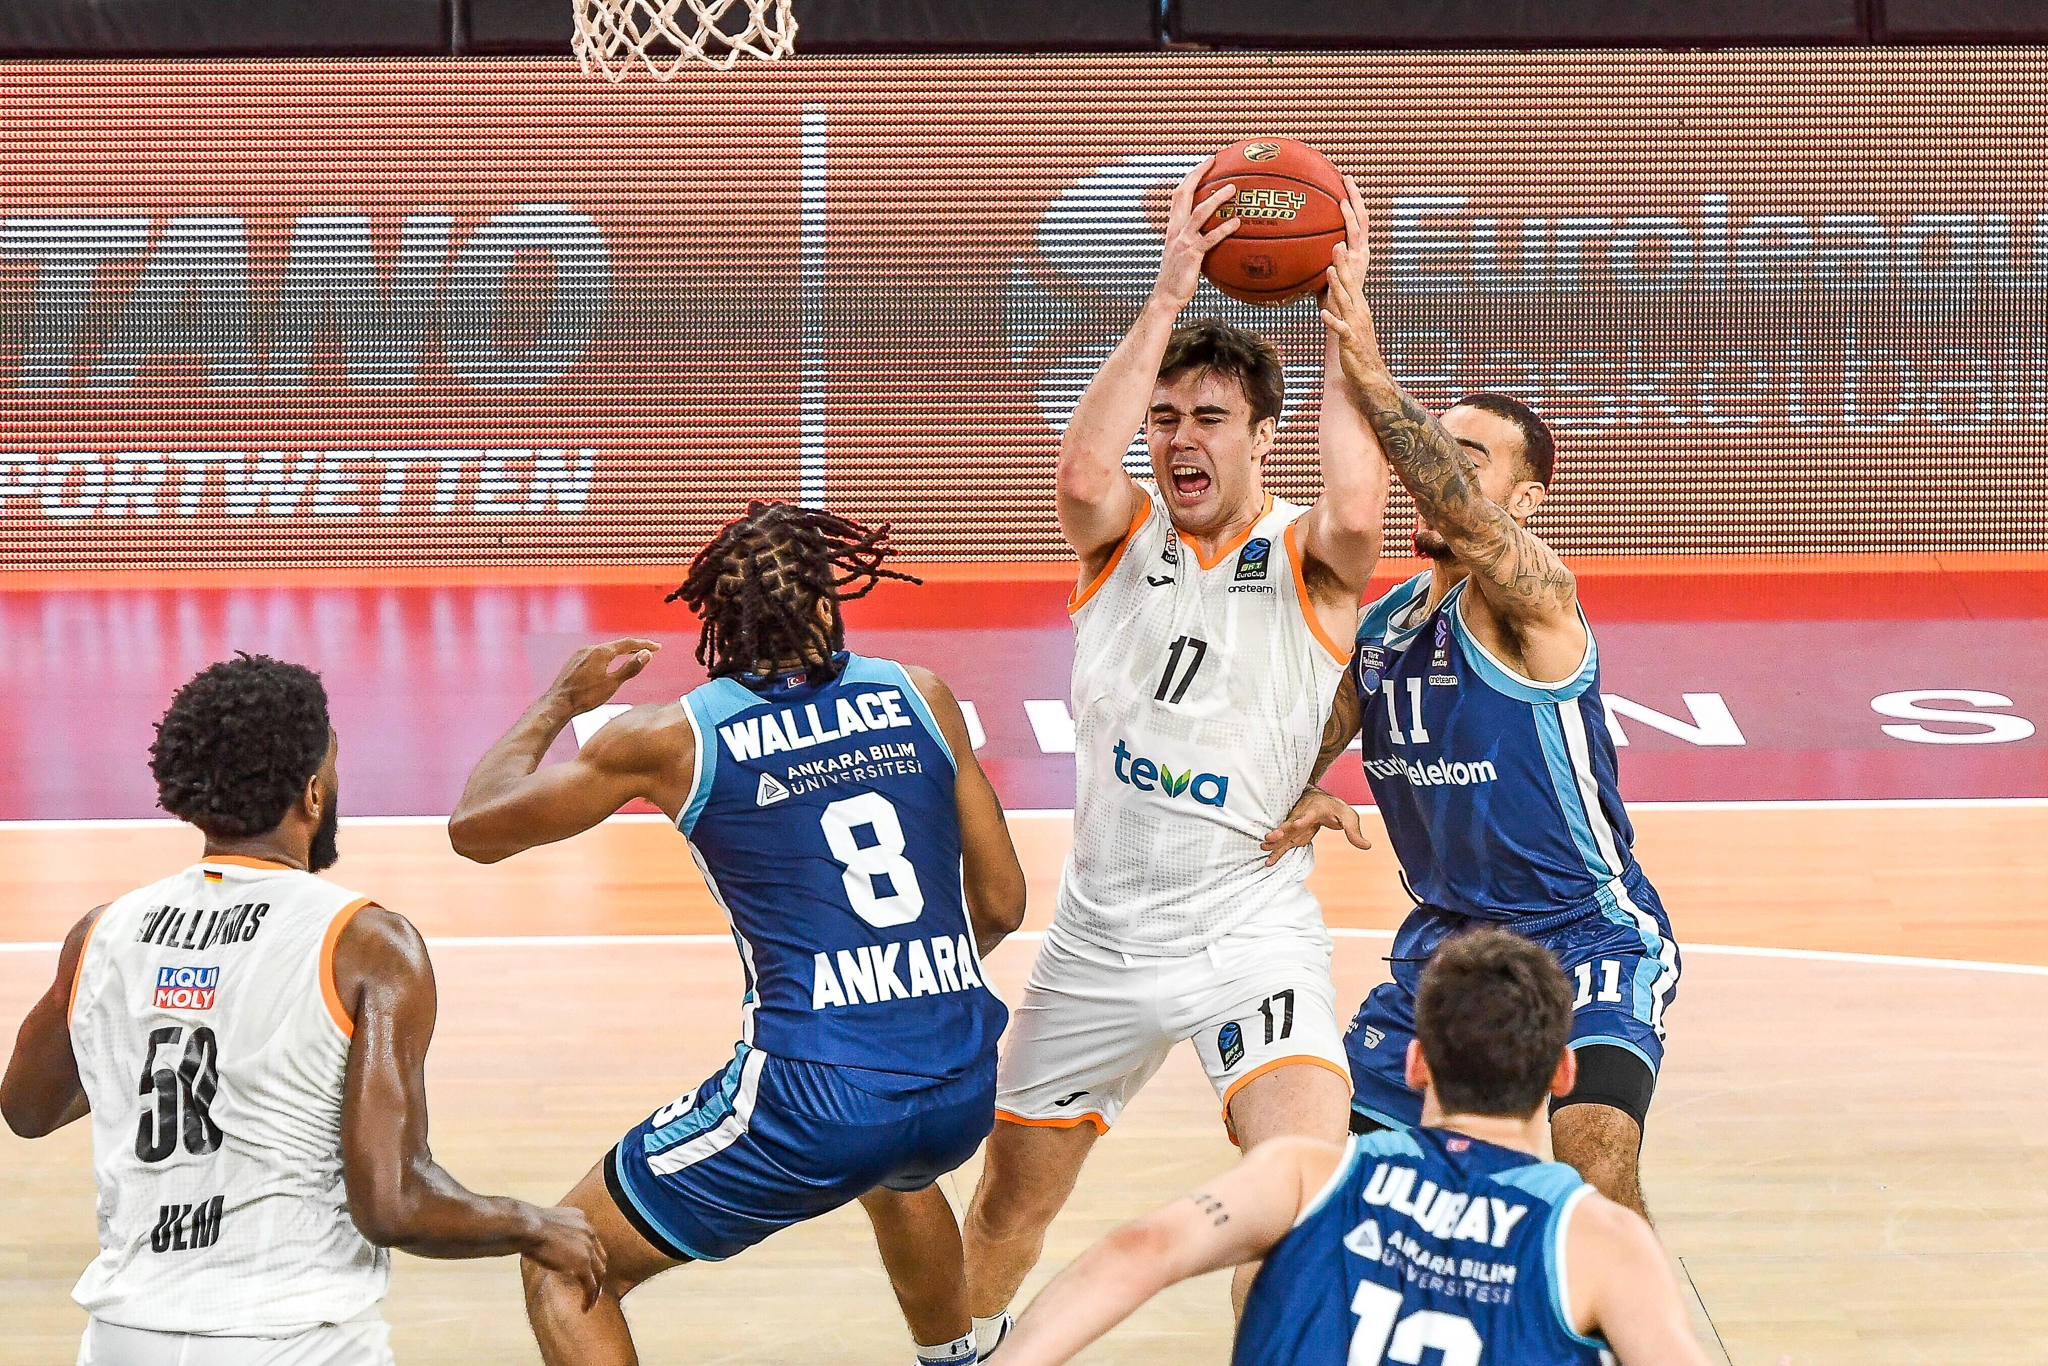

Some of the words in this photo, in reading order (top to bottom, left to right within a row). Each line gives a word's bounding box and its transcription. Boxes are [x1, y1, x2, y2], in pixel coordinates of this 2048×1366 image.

[1230, 188, 1306, 210] GACY
[0, 203, 611, 390] TANO
[1228, 584, 1274, 594] oneteam
[1236, 570, 1266, 579] EuroCup
[1154, 635, 1208, 705] 17
[718, 690, 912, 762] WALLACE
[1382, 677, 1430, 745] 11
[787, 749, 868, 780] ANKARA
[1113, 739, 1229, 808] teva
[820, 791, 925, 929] 8
[155, 989, 215, 1008] MOLY
[159, 967, 218, 988] LIQUI
[812, 934, 984, 1011] ANKARA
[1572, 959, 1622, 1010] 11
[1257, 989, 1294, 1046] 17
[151, 1195, 225, 1253] ULM
[1362, 1163, 1529, 1248] ULUBAY
